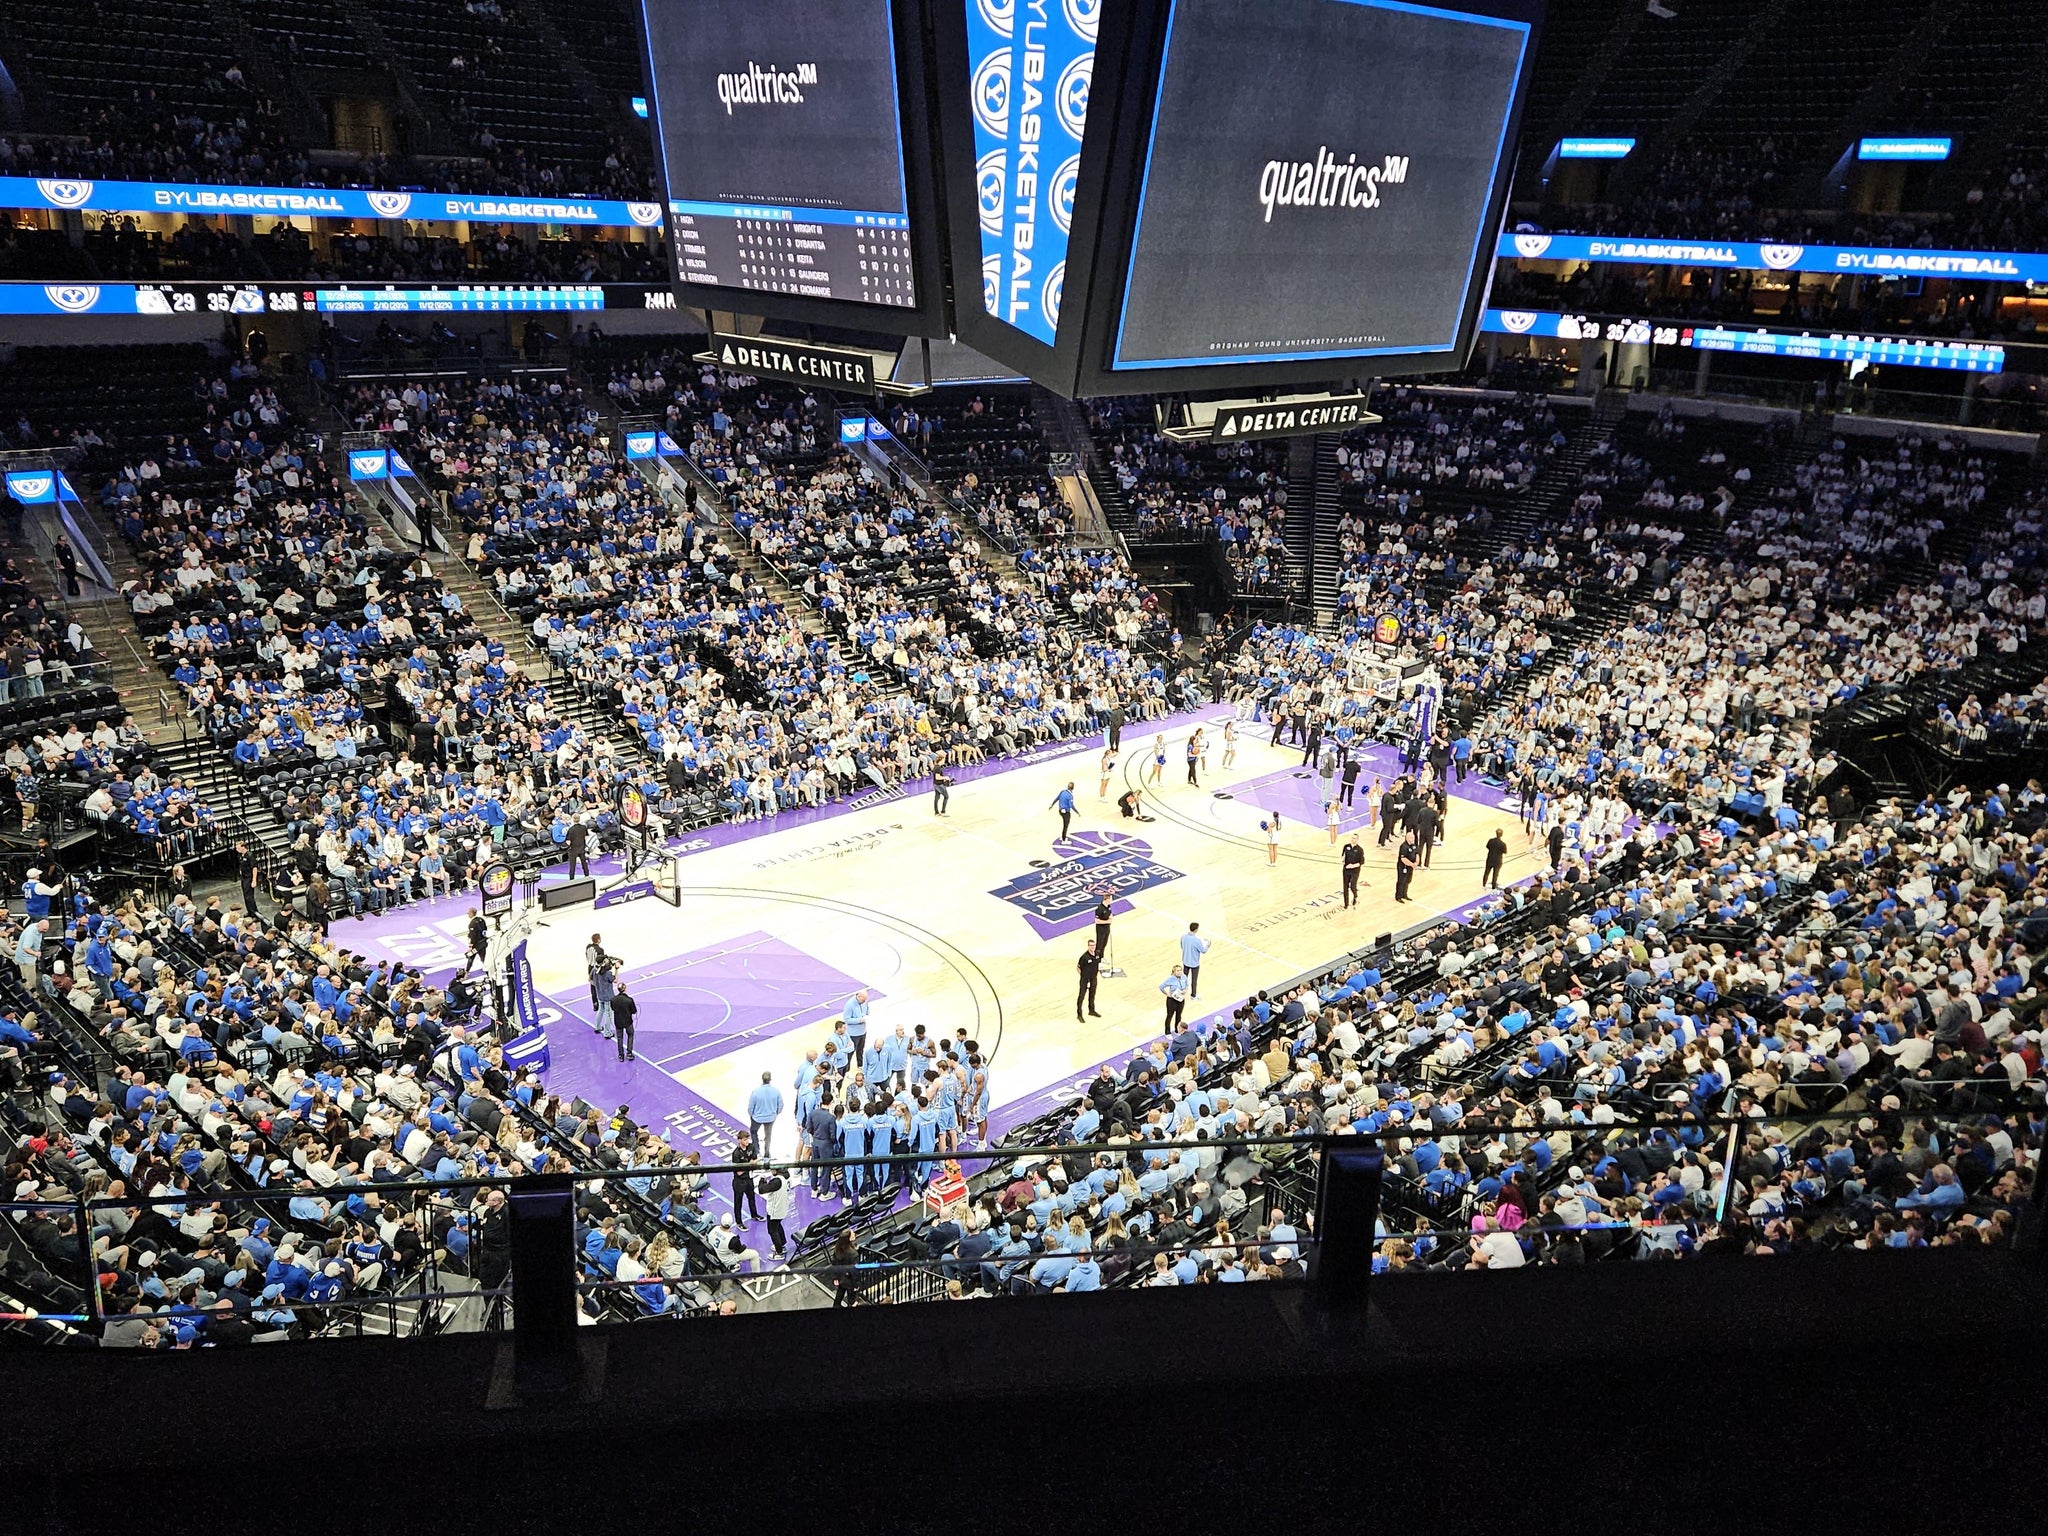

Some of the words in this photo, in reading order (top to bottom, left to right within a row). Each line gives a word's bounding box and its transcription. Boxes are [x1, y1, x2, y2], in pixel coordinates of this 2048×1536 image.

[173, 292, 196, 311] 29
[208, 292, 230, 311] 35
[1583, 322, 1600, 338] 29
[1210, 342, 1250, 350] BRIGHAM
[1254, 340, 1281, 348] YOUNG
[1285, 337, 1335, 346] UNIVERSITY
[1338, 335, 1387, 344] BASKETBALL
[738, 347, 794, 372] DELTA
[798, 356, 866, 384] CENTER
[1241, 412, 1295, 433] DELTA
[1300, 405, 1358, 428] CENTER
[1021, 860, 1140, 902] MOWERS
[1112, 864, 1172, 886] BAD
[1037, 890, 1094, 914] BOY
[1306, 890, 1344, 908] ELTA
[1244, 906, 1308, 933] CENTER
[520, 959, 528, 982] FIRST
[522, 982, 534, 1020] AMERICA
[690, 1104, 714, 1120] UTAH
[663, 1110, 738, 1161] EALTH
